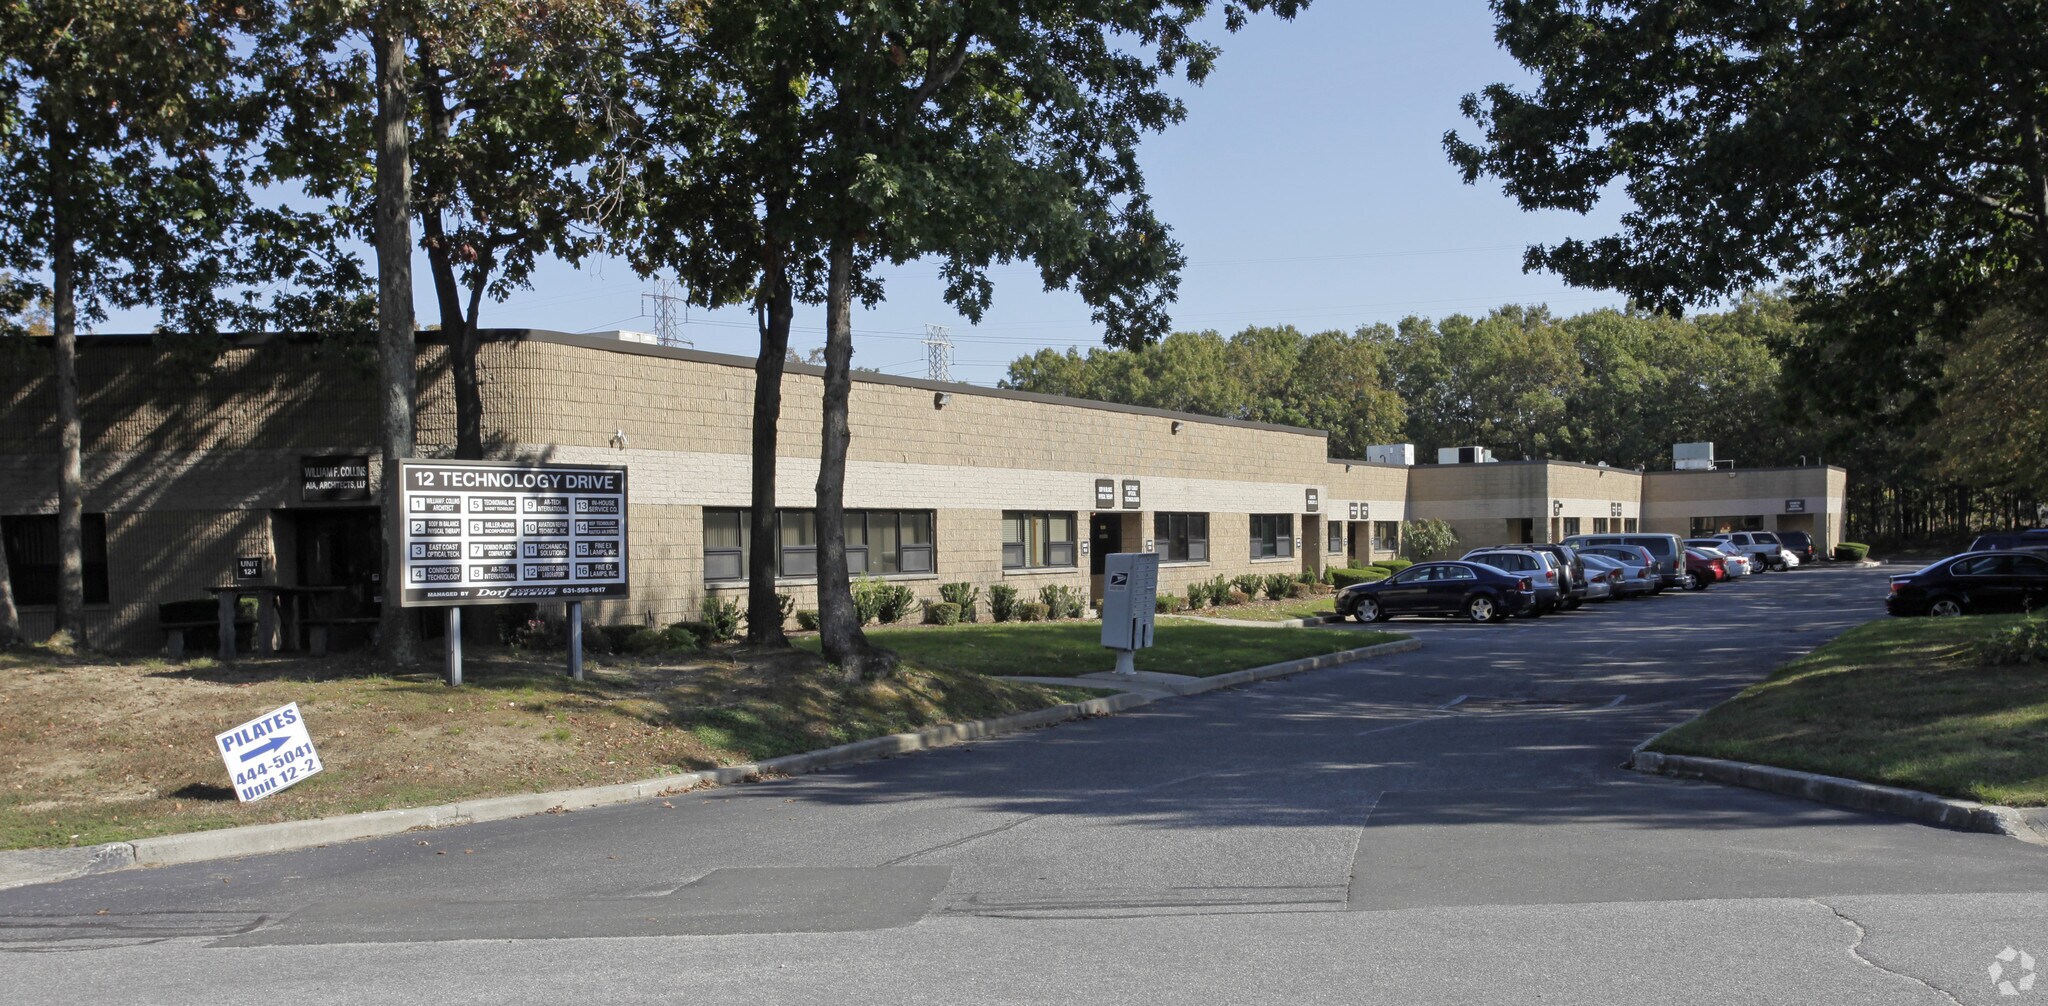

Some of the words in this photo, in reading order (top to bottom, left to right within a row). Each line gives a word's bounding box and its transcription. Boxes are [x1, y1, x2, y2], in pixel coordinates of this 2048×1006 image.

[305, 467, 333, 477] WILLIAM
[341, 466, 366, 477] COLLINS
[415, 472, 434, 486] 12
[439, 472, 561, 488] TECHNOLOGY
[566, 475, 614, 489] DRIVE
[306, 482, 318, 490] AIA,
[416, 500, 420, 508] 1
[528, 501, 533, 509] 9
[415, 523, 422, 532] 2
[415, 547, 422, 555] 3
[474, 546, 480, 554] 7
[415, 570, 422, 578] 4
[474, 569, 480, 577] 8
[526, 568, 536, 576] 12
[578, 567, 587, 575] 16
[476, 588, 512, 598] Dorf
[222, 709, 297, 752] PILATES
[237, 743, 312, 785] 444-5041
[242, 777, 278, 800] Unit
[279, 759, 316, 782] 12-2
